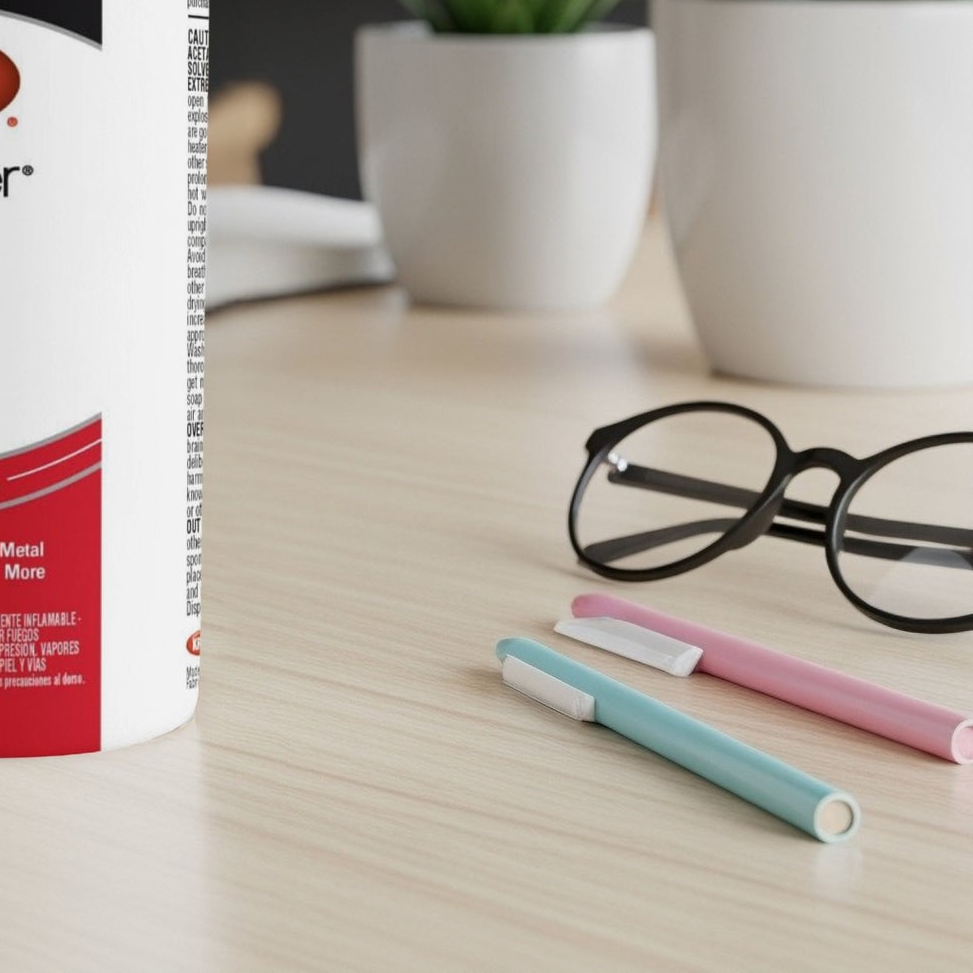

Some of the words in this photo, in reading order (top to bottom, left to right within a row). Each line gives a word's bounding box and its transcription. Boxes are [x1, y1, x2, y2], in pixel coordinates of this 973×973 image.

[0, 541, 44, 557] Metal
[5, 564, 45, 580] More
[23, 611, 77, 627] INFLAMABLE
[6, 628, 40, 642] FUEGOS
[40, 640, 80, 656] VAPORES
[0, 658, 17, 673] PIEL
[19, 658, 25, 672] Y
